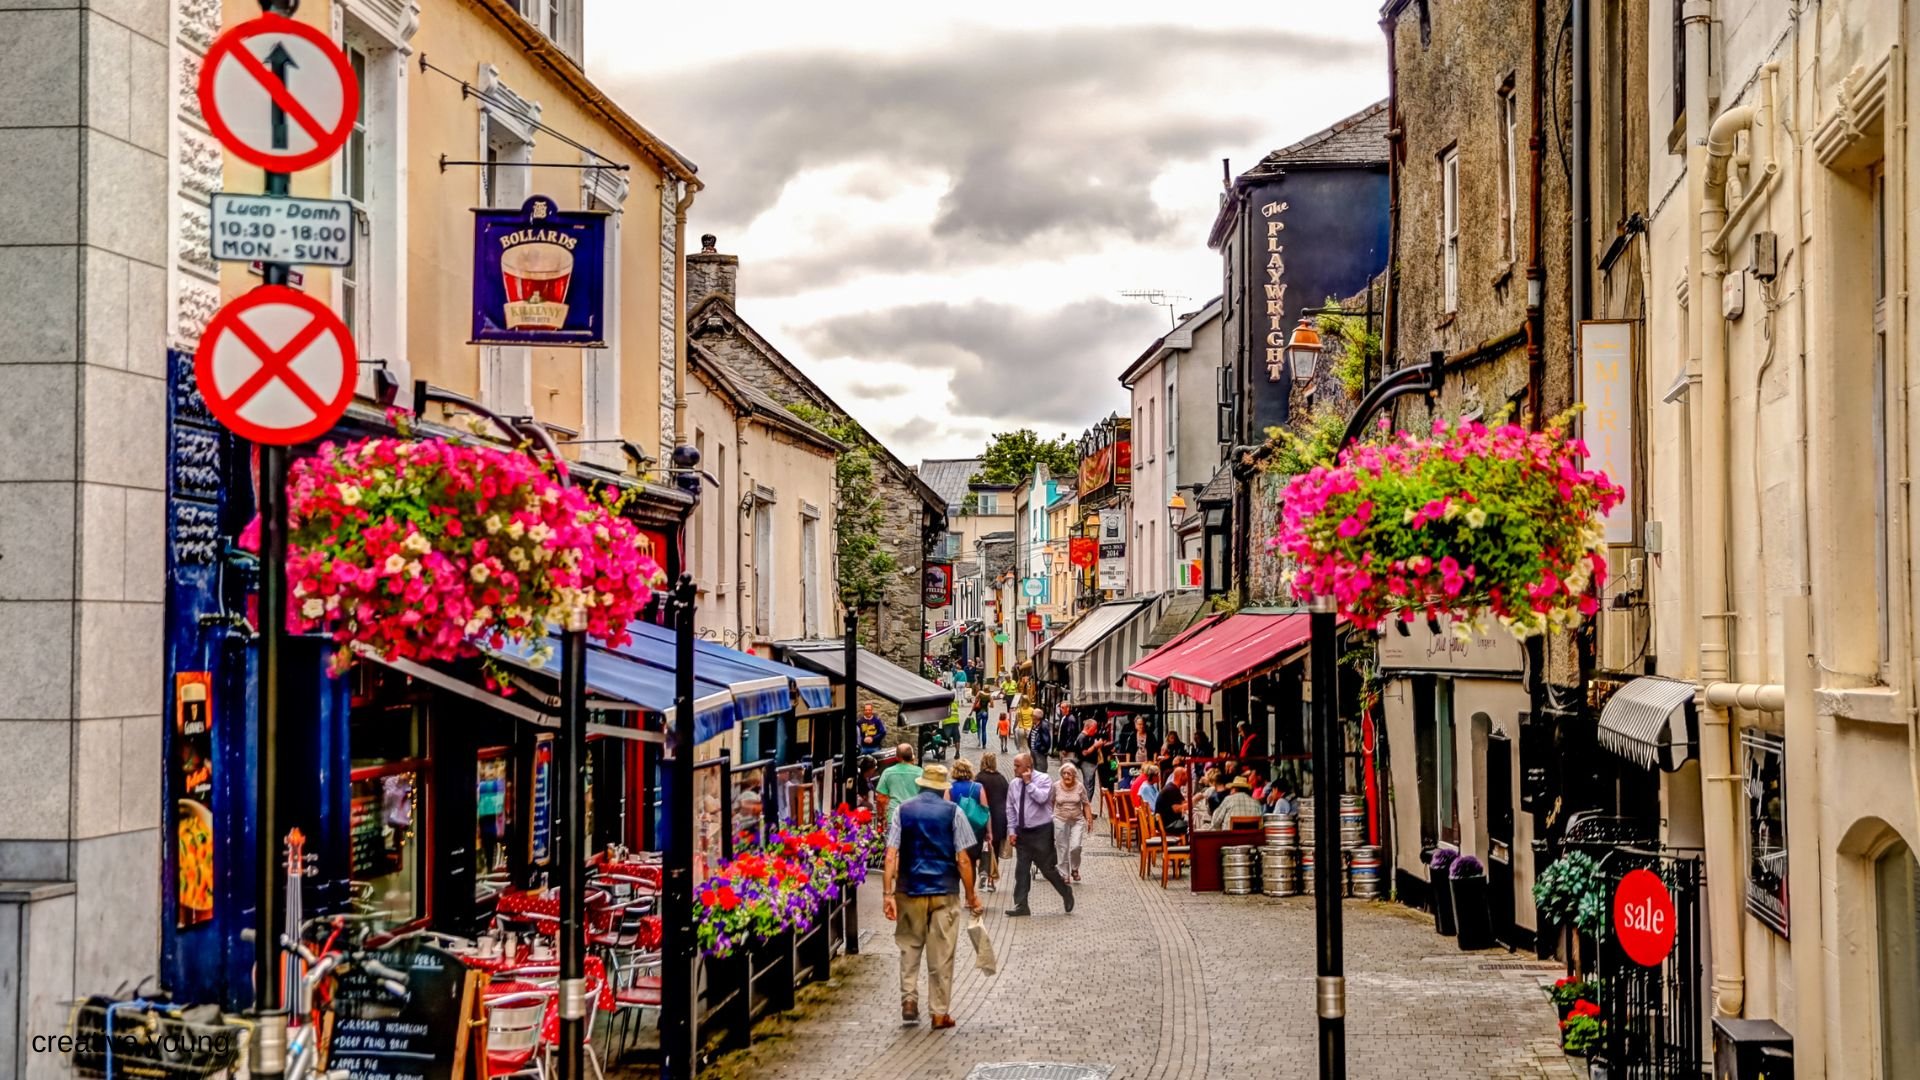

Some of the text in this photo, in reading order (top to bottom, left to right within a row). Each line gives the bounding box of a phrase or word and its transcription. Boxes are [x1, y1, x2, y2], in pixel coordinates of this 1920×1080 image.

[225, 200, 272, 217] Luan
[286, 203, 340, 221] Domh
[220, 221, 276, 238] 10:30
[291, 225, 346, 242] 18:00
[500, 229, 578, 250] BOLLARDS
[222, 240, 279, 259] MON.
[294, 244, 345, 261] SUN.
[1261, 201, 1290, 382] The PLAYWRIGHT
[1624, 896, 1665, 935] sale
